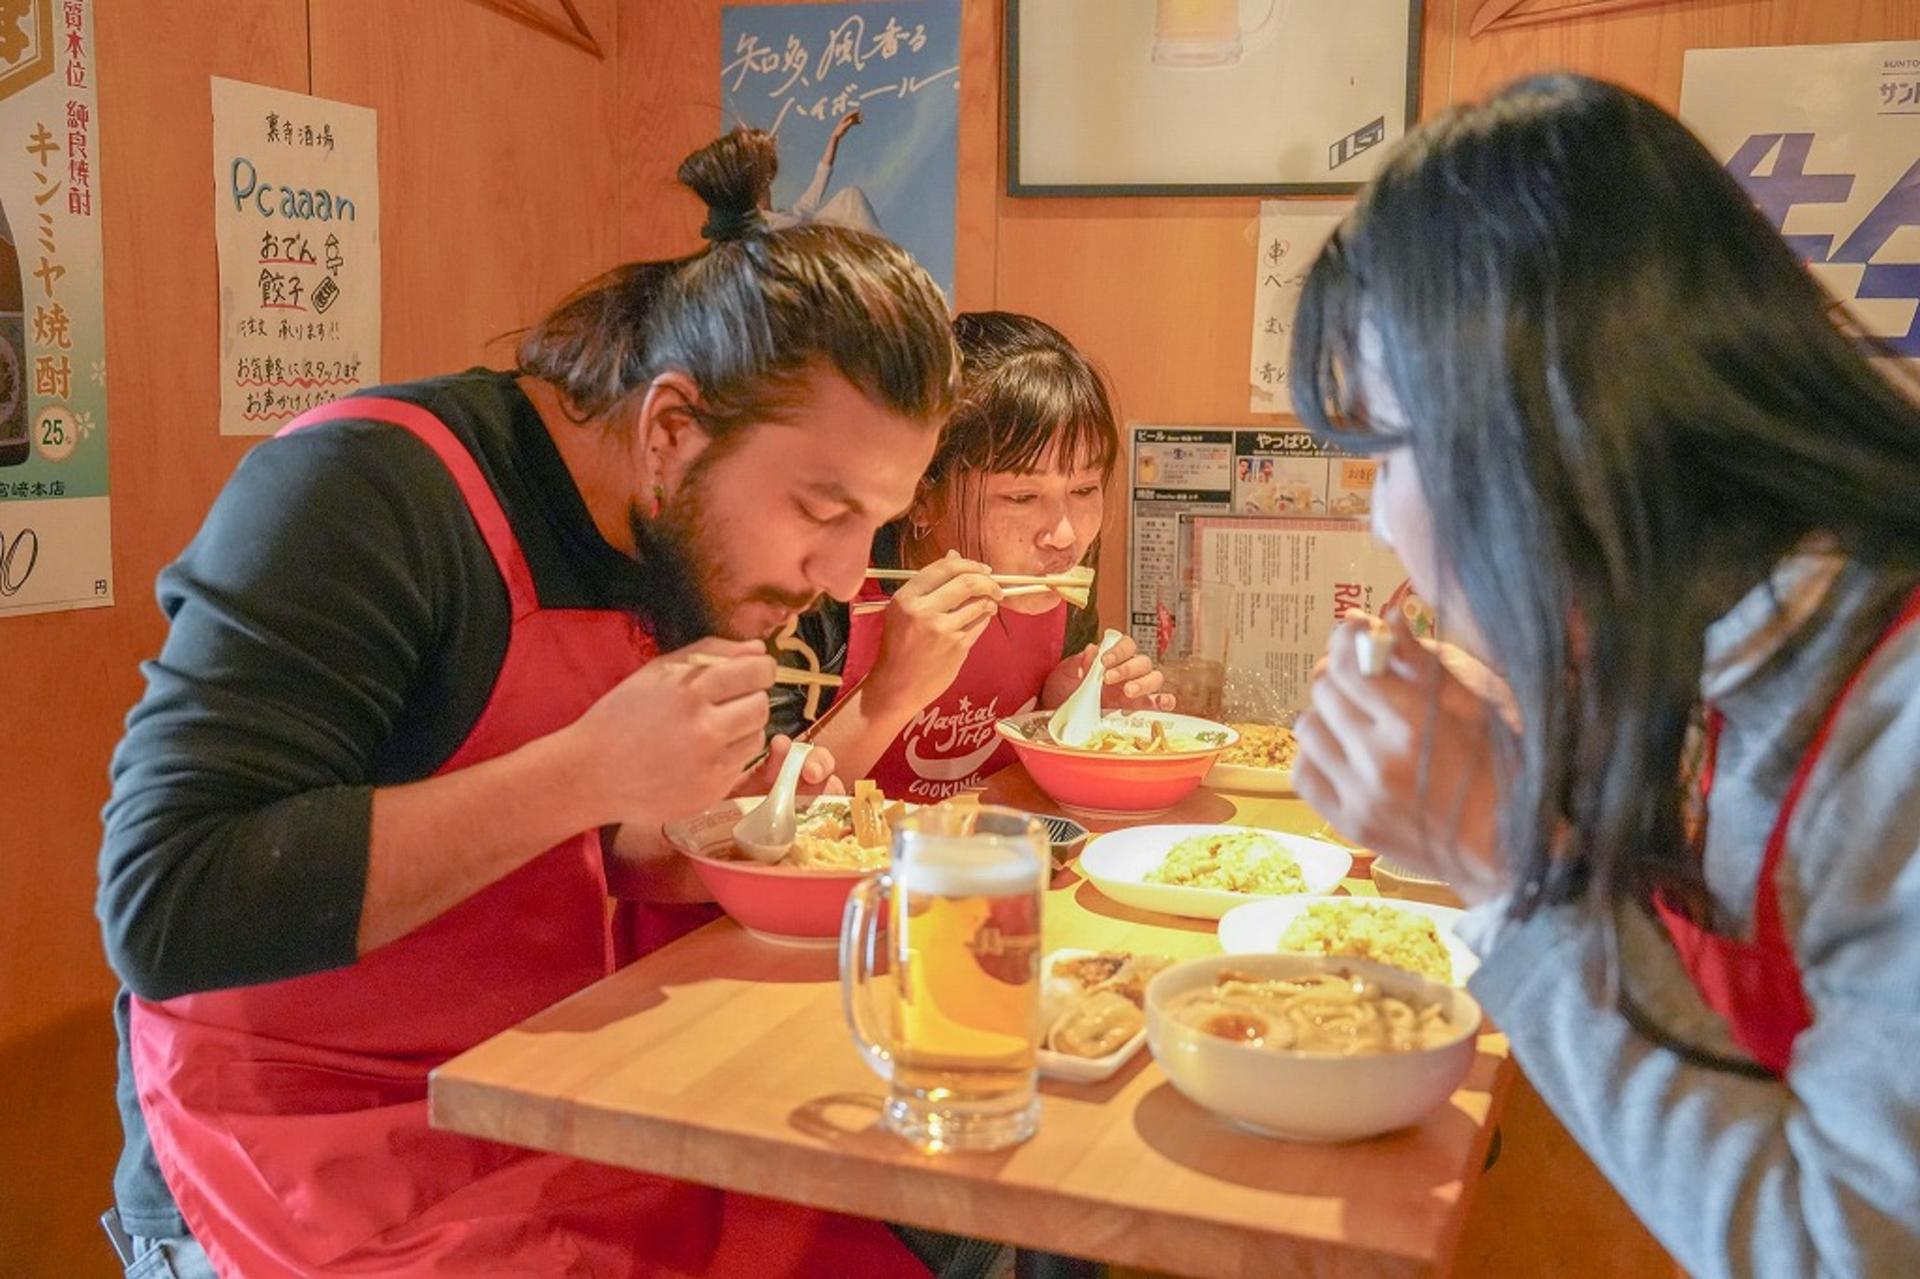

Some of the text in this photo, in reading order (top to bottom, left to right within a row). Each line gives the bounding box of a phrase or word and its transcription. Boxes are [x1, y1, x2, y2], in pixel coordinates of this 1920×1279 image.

[1883, 59, 1920, 68] SUNTO
[25, 122, 73, 400] キンミヤ焼酎
[260, 230, 317, 262] おでん
[258, 267, 304, 306] 餃子
[42, 419, 64, 445] 25
[95, 579, 108, 595] 円
[1334, 583, 1362, 622] RA
[903, 696, 998, 752] Magical
[957, 725, 992, 748] Trip
